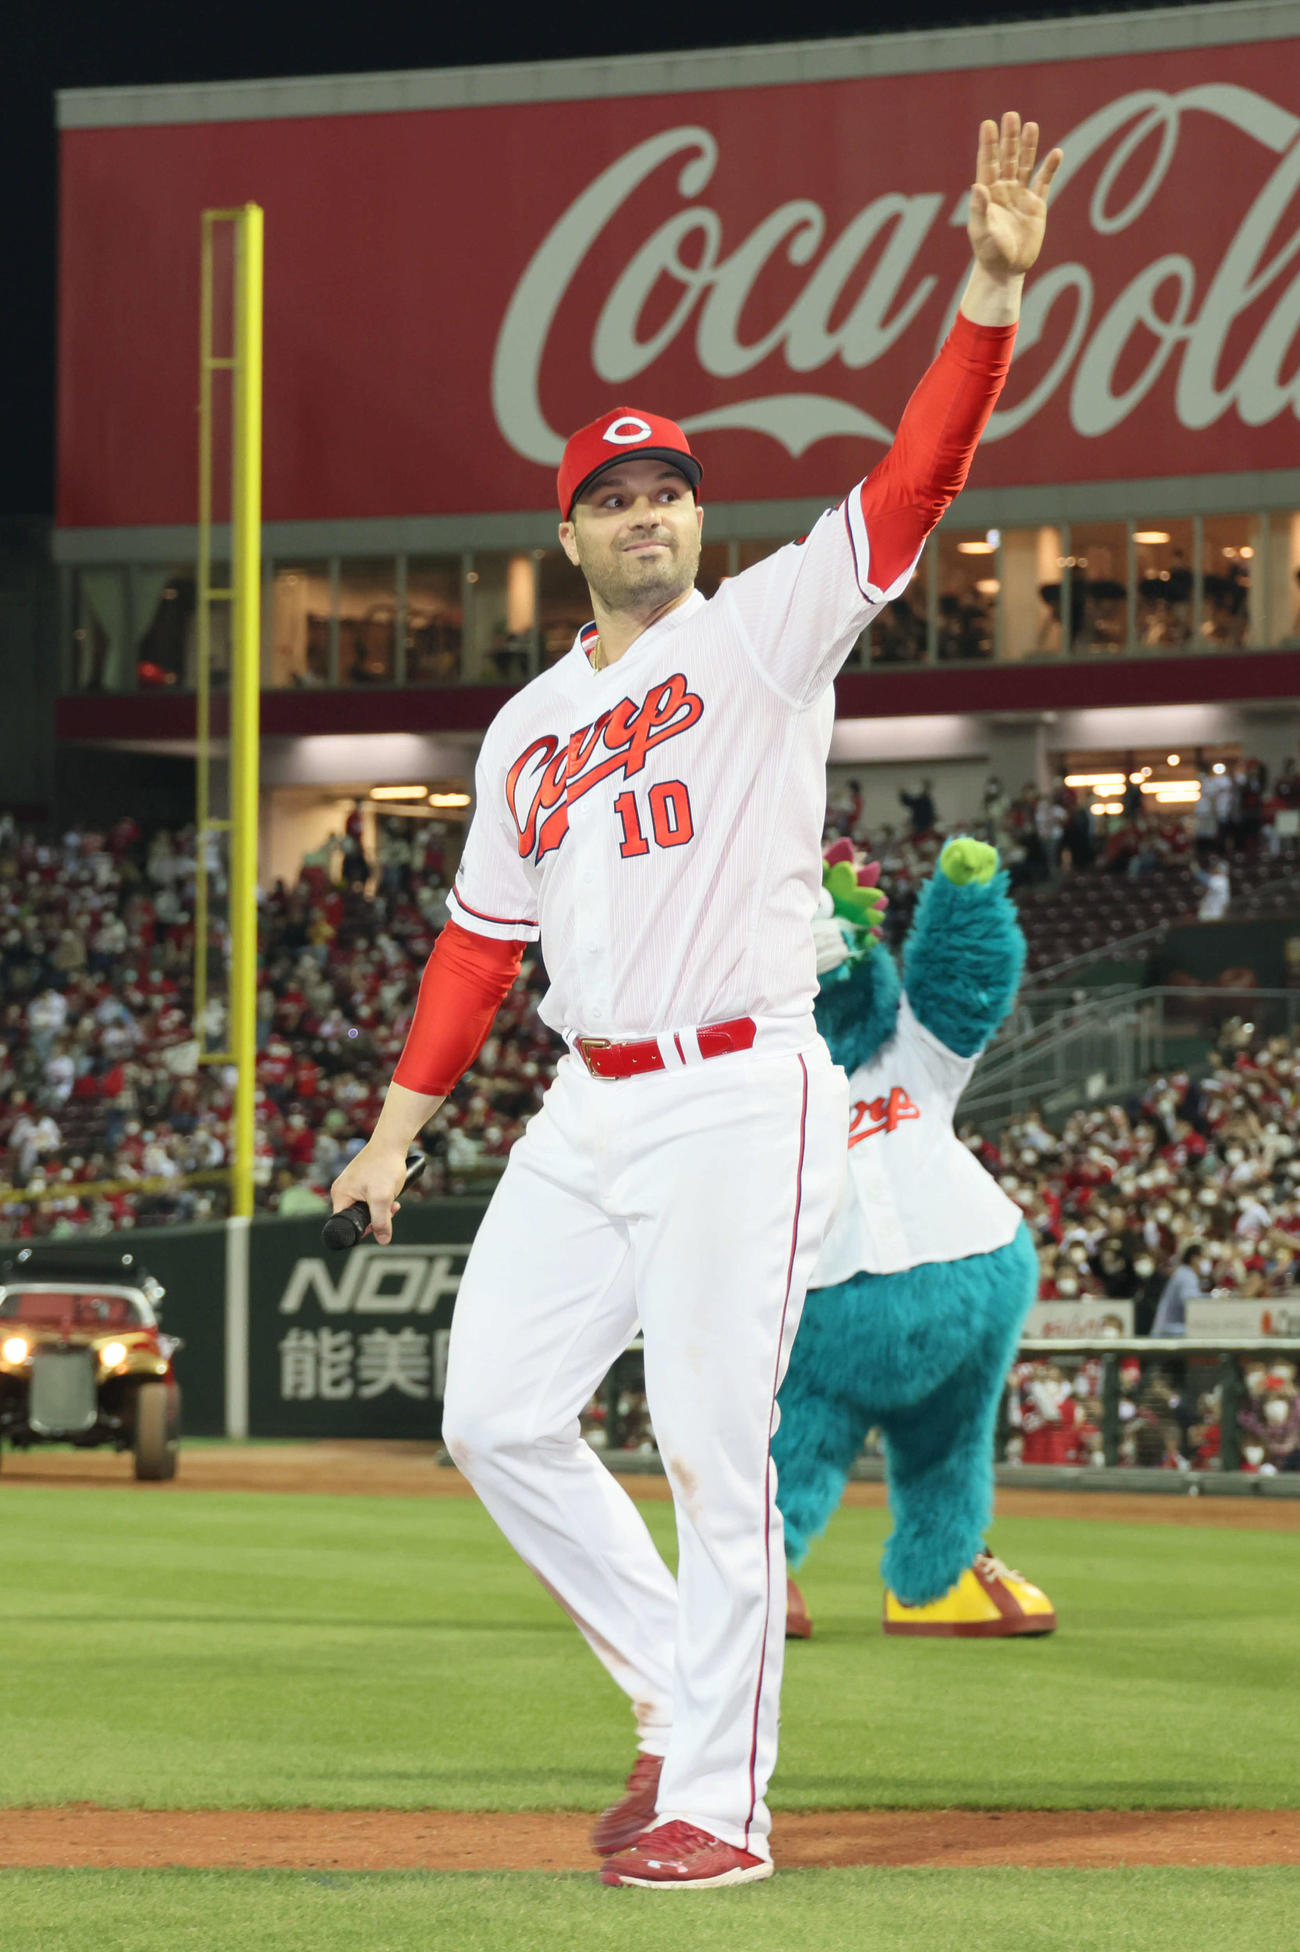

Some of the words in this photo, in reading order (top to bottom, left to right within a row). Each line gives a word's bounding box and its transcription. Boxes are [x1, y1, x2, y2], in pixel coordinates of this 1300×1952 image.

[602, 416, 652, 445] C
[506, 673, 704, 867] Carp
[614, 779, 694, 859] 10
[278, 1326, 450, 1399] 能美
